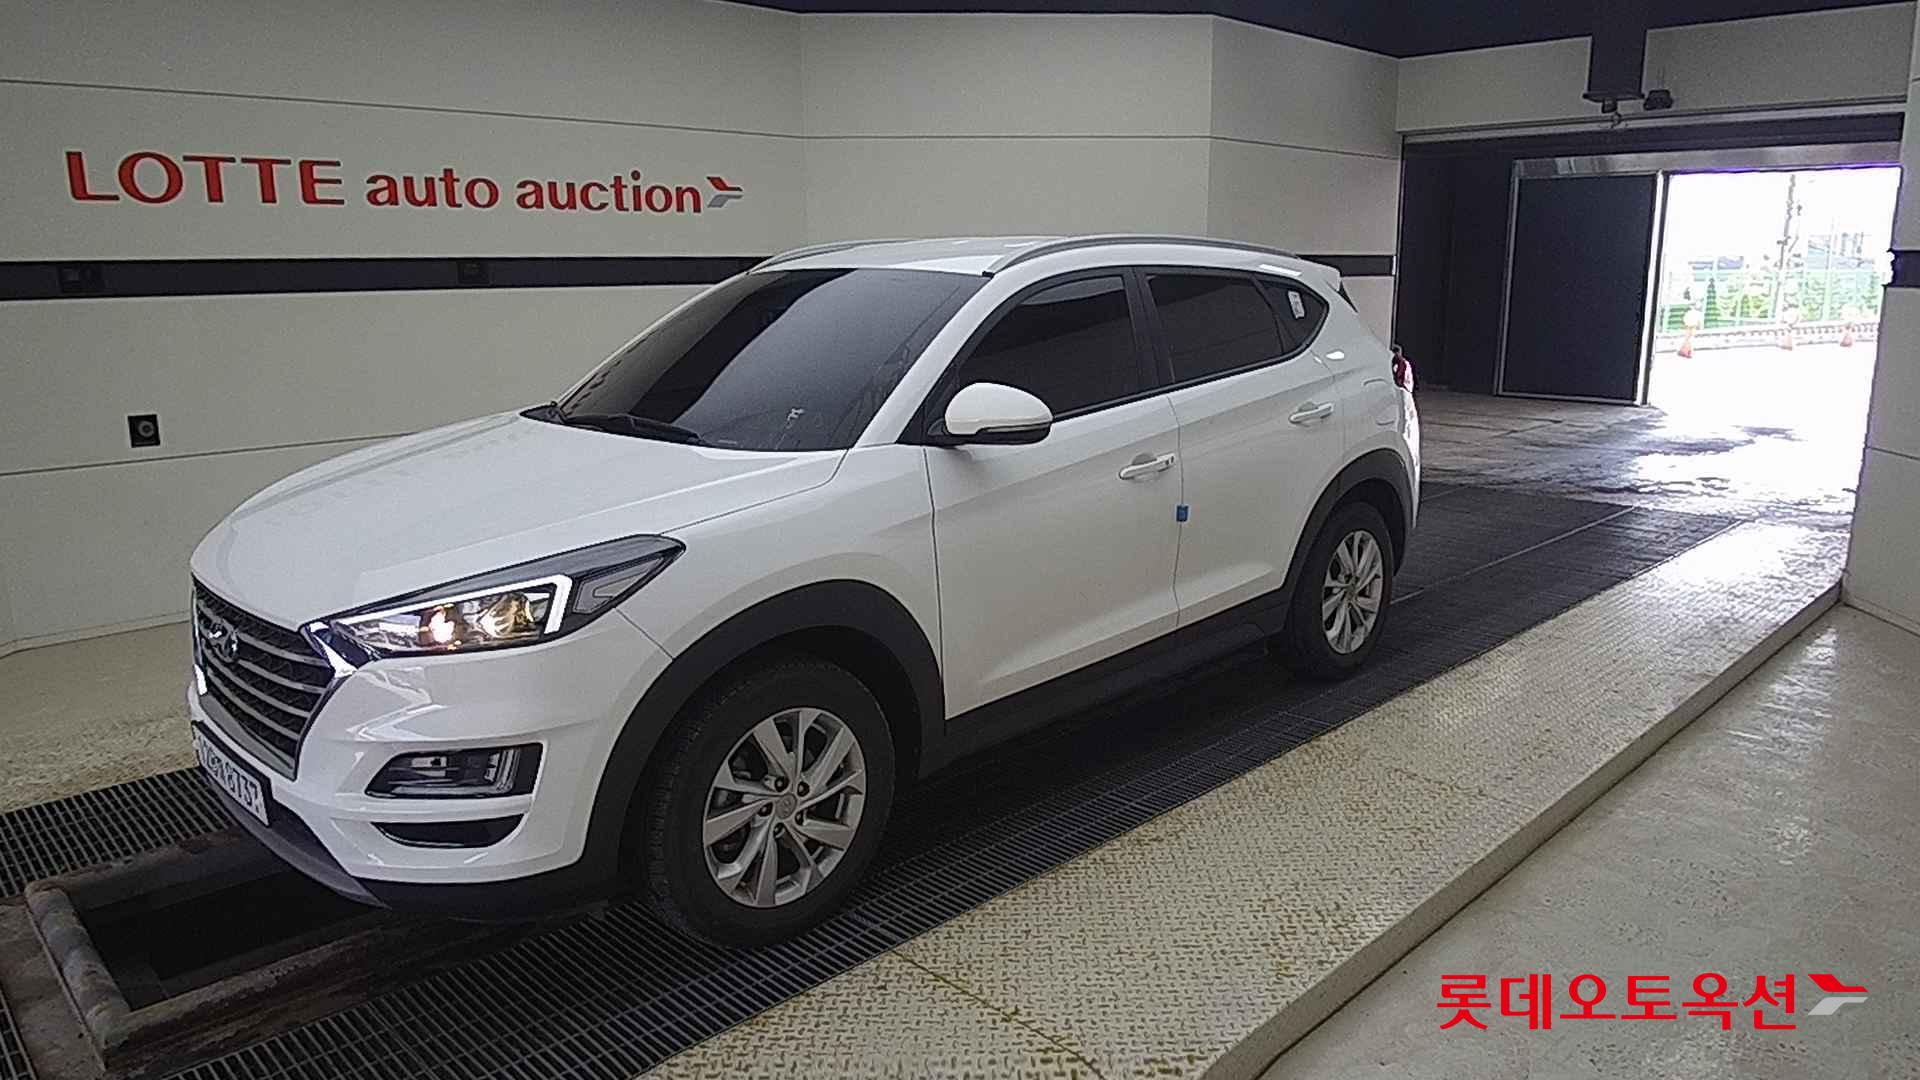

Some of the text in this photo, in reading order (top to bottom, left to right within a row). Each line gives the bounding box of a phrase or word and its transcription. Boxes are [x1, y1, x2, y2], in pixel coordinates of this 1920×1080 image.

[66, 151, 702, 214] LOTTE auto auction
